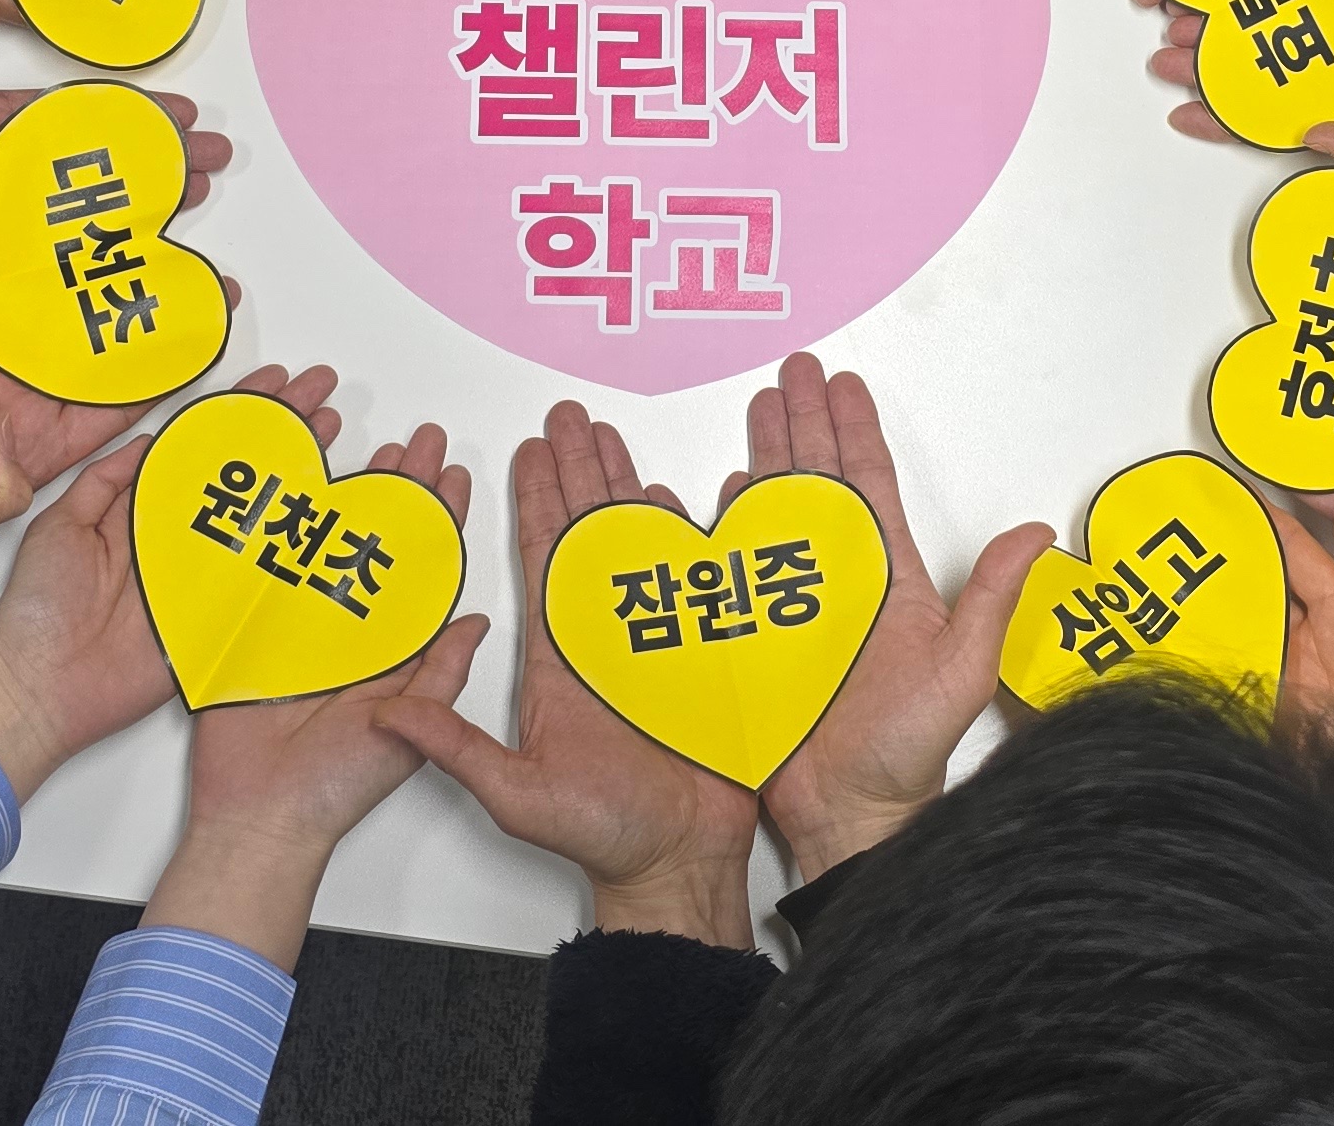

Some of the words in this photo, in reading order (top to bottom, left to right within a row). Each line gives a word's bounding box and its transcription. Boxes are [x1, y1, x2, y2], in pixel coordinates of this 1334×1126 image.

[456, 2, 841, 143] 챌린저
[46, 147, 160, 355] 대선초
[518, 181, 786, 326] 학교
[190, 459, 395, 620] 원천초
[612, 540, 824, 654] 잠원중
[1050, 517, 1228, 676] 삼일고
